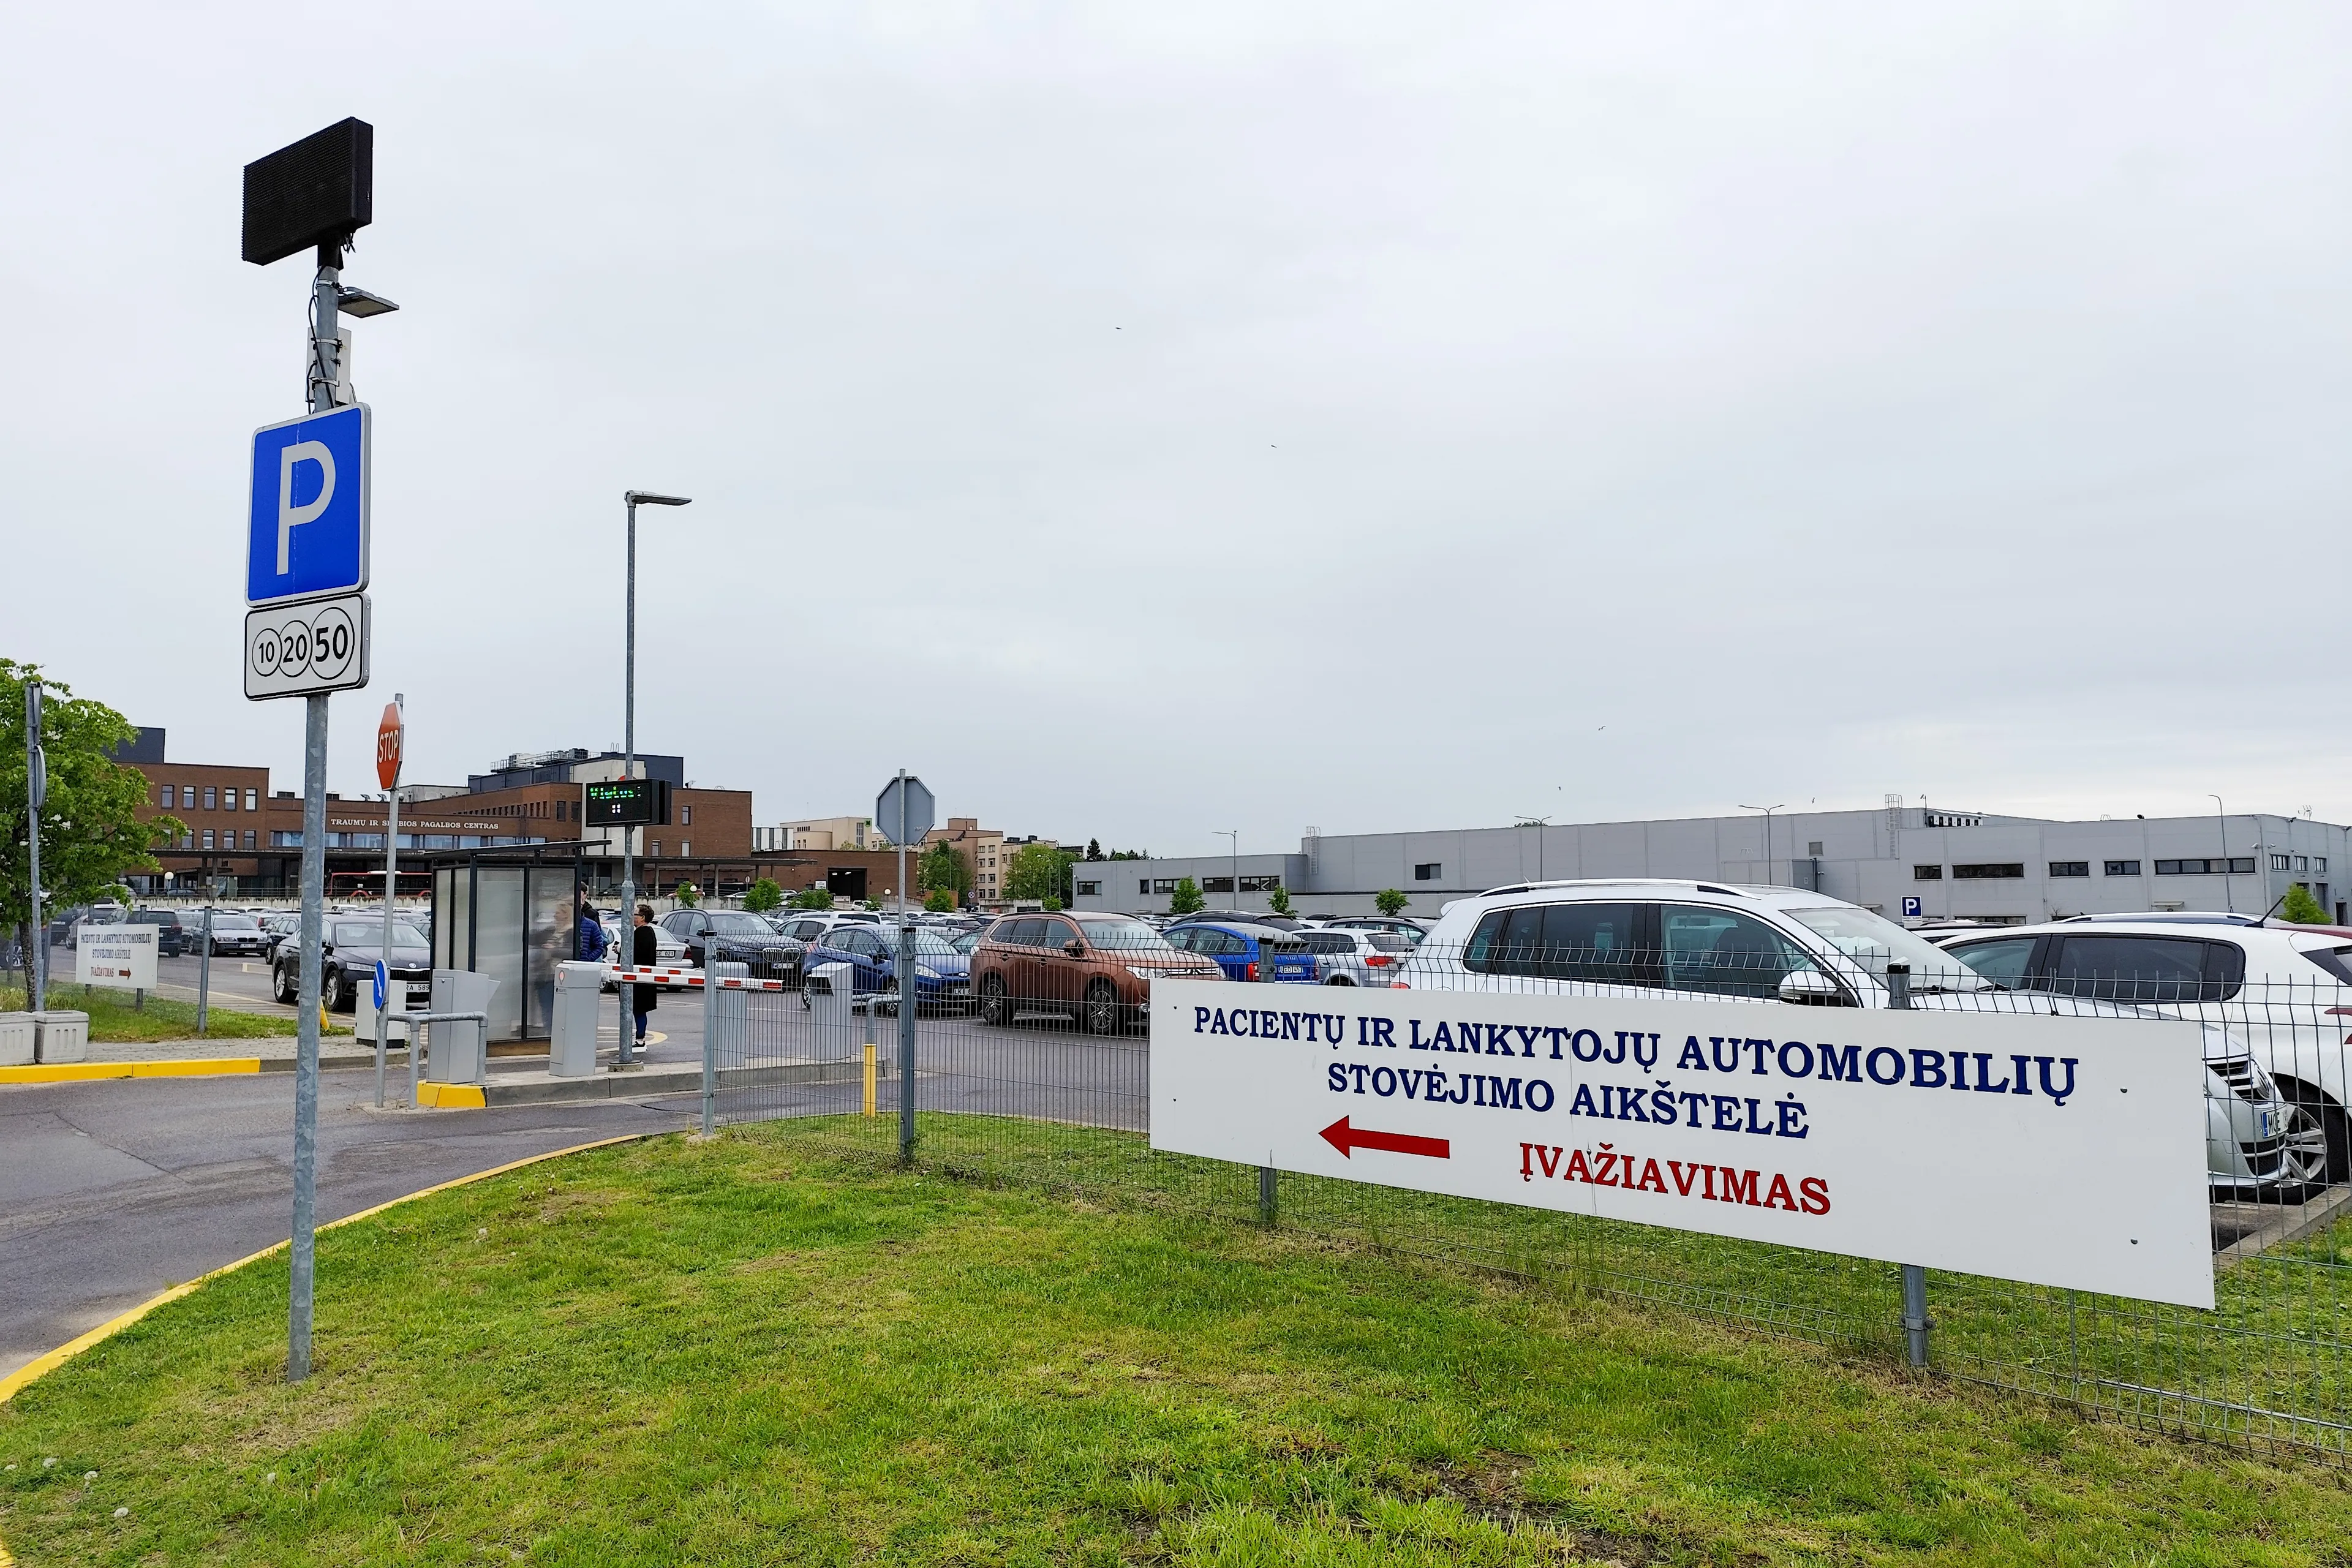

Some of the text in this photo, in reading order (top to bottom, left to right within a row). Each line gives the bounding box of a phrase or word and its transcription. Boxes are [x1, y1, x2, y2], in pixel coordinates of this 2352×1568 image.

[276, 440, 336, 576] P
[258, 624, 349, 663] 10 20 50
[378, 729, 399, 764] STOP
[1905, 898, 1917, 915] P
[1194, 1006, 2079, 1107] PACIENTŲ IR LANKYTOJŲ AUTOMOBILIŲ
[1328, 1063, 1809, 1139] STOVĖJIMO AIKŠTELĖ
[1520, 1142, 1831, 1215] ĮVAŽIAVIMAS
